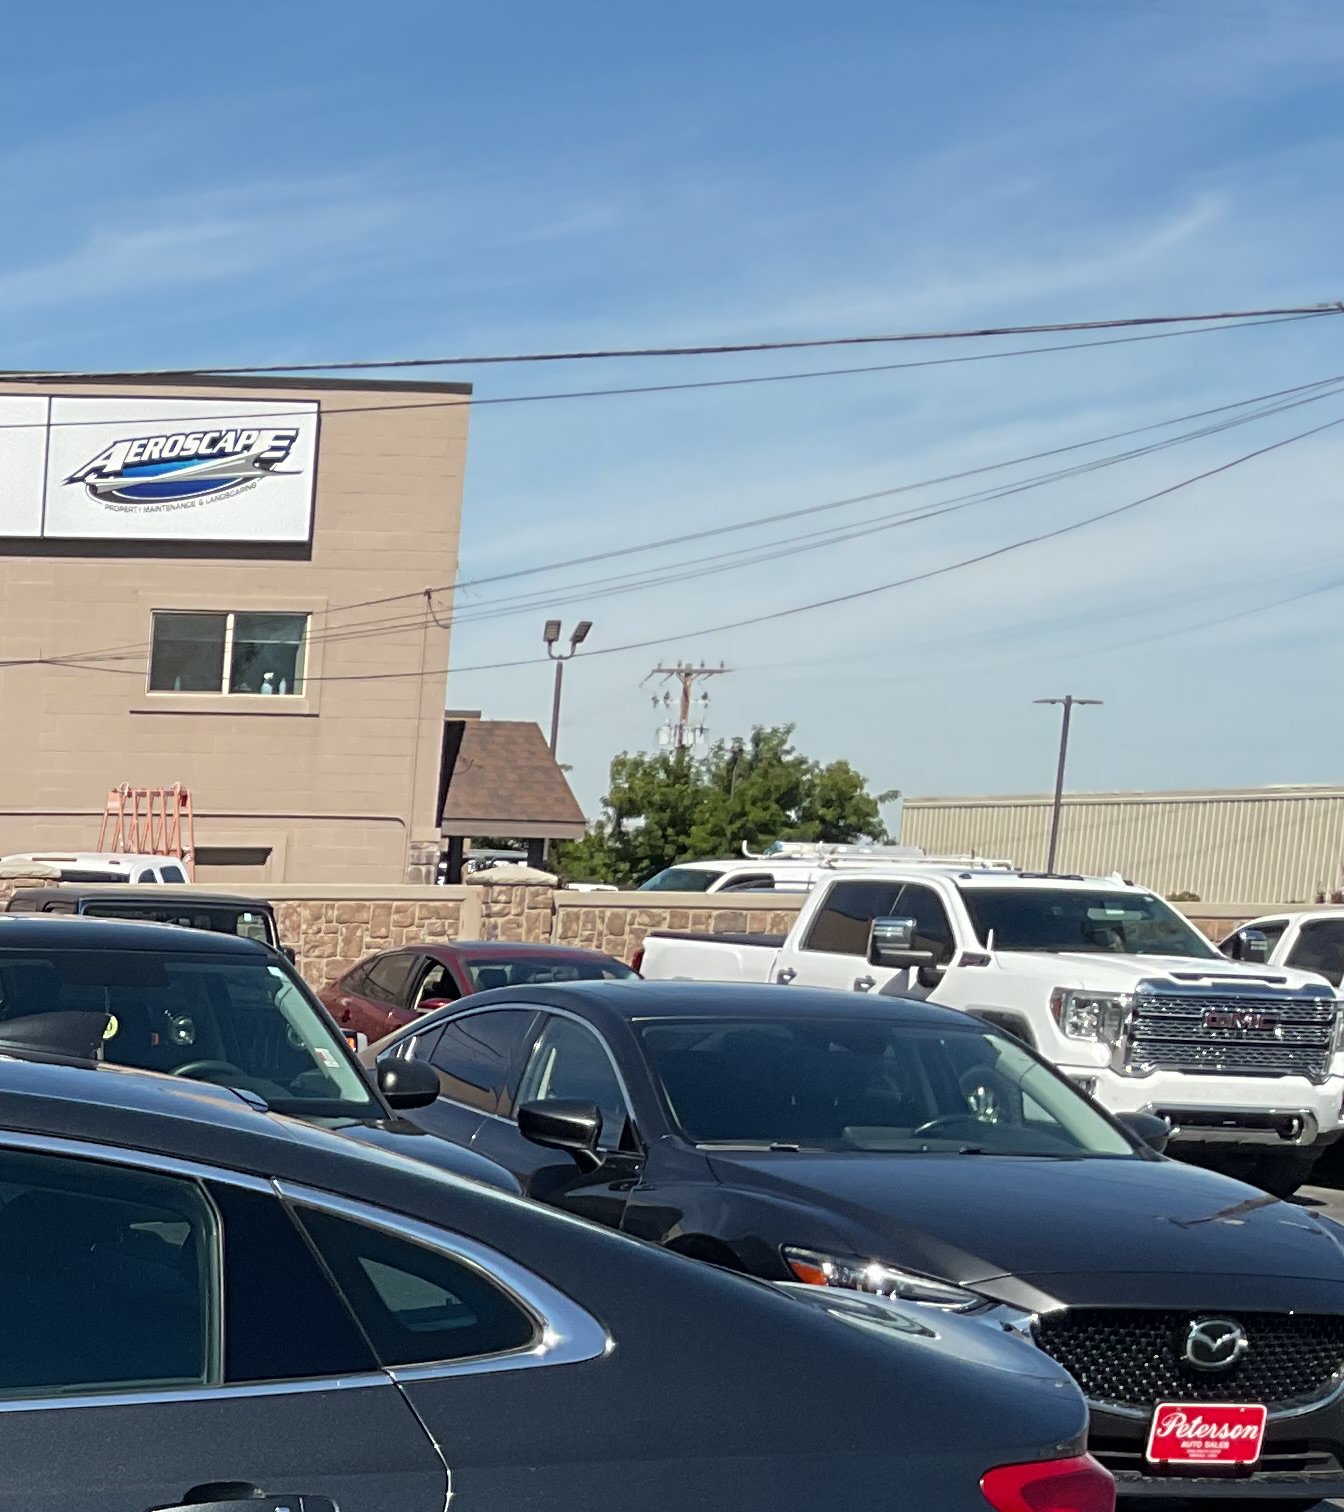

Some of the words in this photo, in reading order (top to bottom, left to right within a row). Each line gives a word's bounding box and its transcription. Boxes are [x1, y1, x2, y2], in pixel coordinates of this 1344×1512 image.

[62, 428, 300, 486] AEROSCAPE
[105, 503, 142, 513] PROPERTY
[143, 501, 196, 513] MAINTENANCE
[206, 482, 258, 505] LANDSCAPING
[1205, 1012, 1278, 1029] GMC
[1156, 1412, 1259, 1440] Peterson
[1180, 1440, 1202, 1449] AUTO
[1204, 1440, 1230, 1449] SALES
